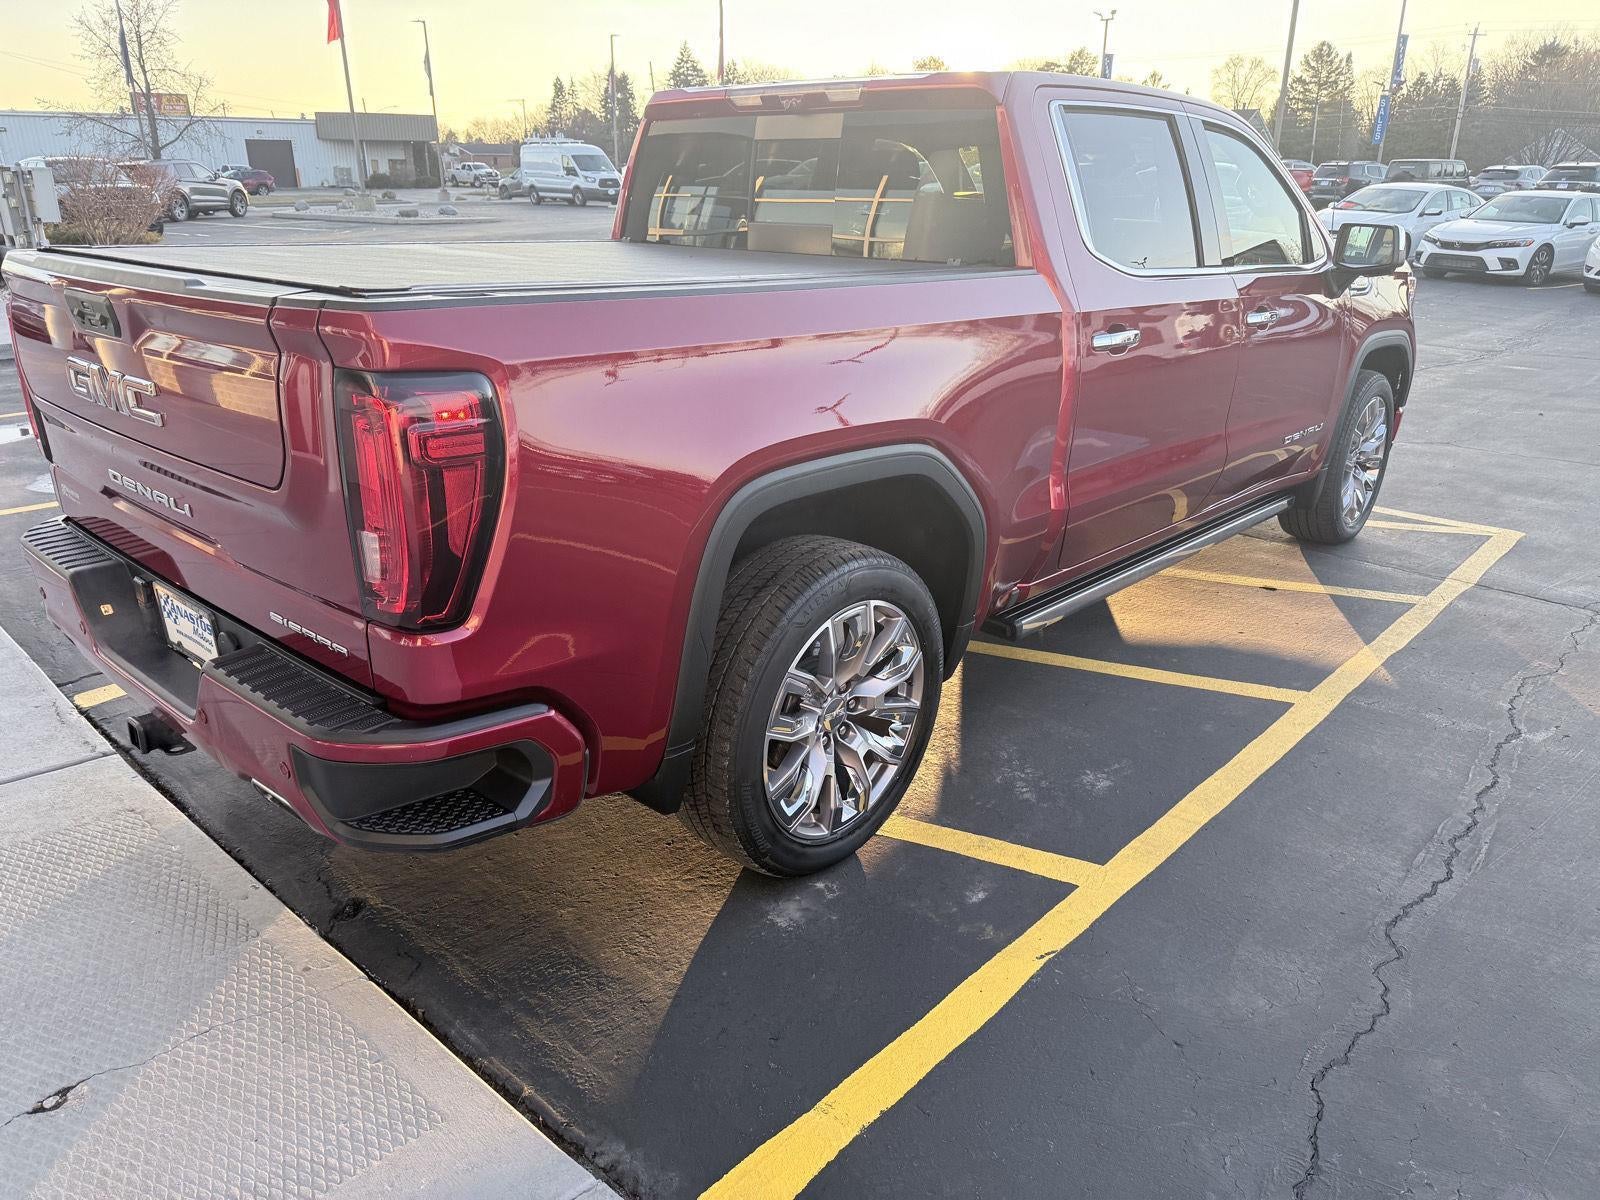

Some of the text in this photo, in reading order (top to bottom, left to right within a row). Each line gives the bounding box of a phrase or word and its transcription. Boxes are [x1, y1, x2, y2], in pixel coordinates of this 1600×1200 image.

[1374, 98, 1387, 141] SALES
[66, 356, 165, 428] GMC
[107, 468, 194, 519] DENALI
[169, 600, 214, 637] ANASTOS
[269, 611, 349, 658] SIERRA
